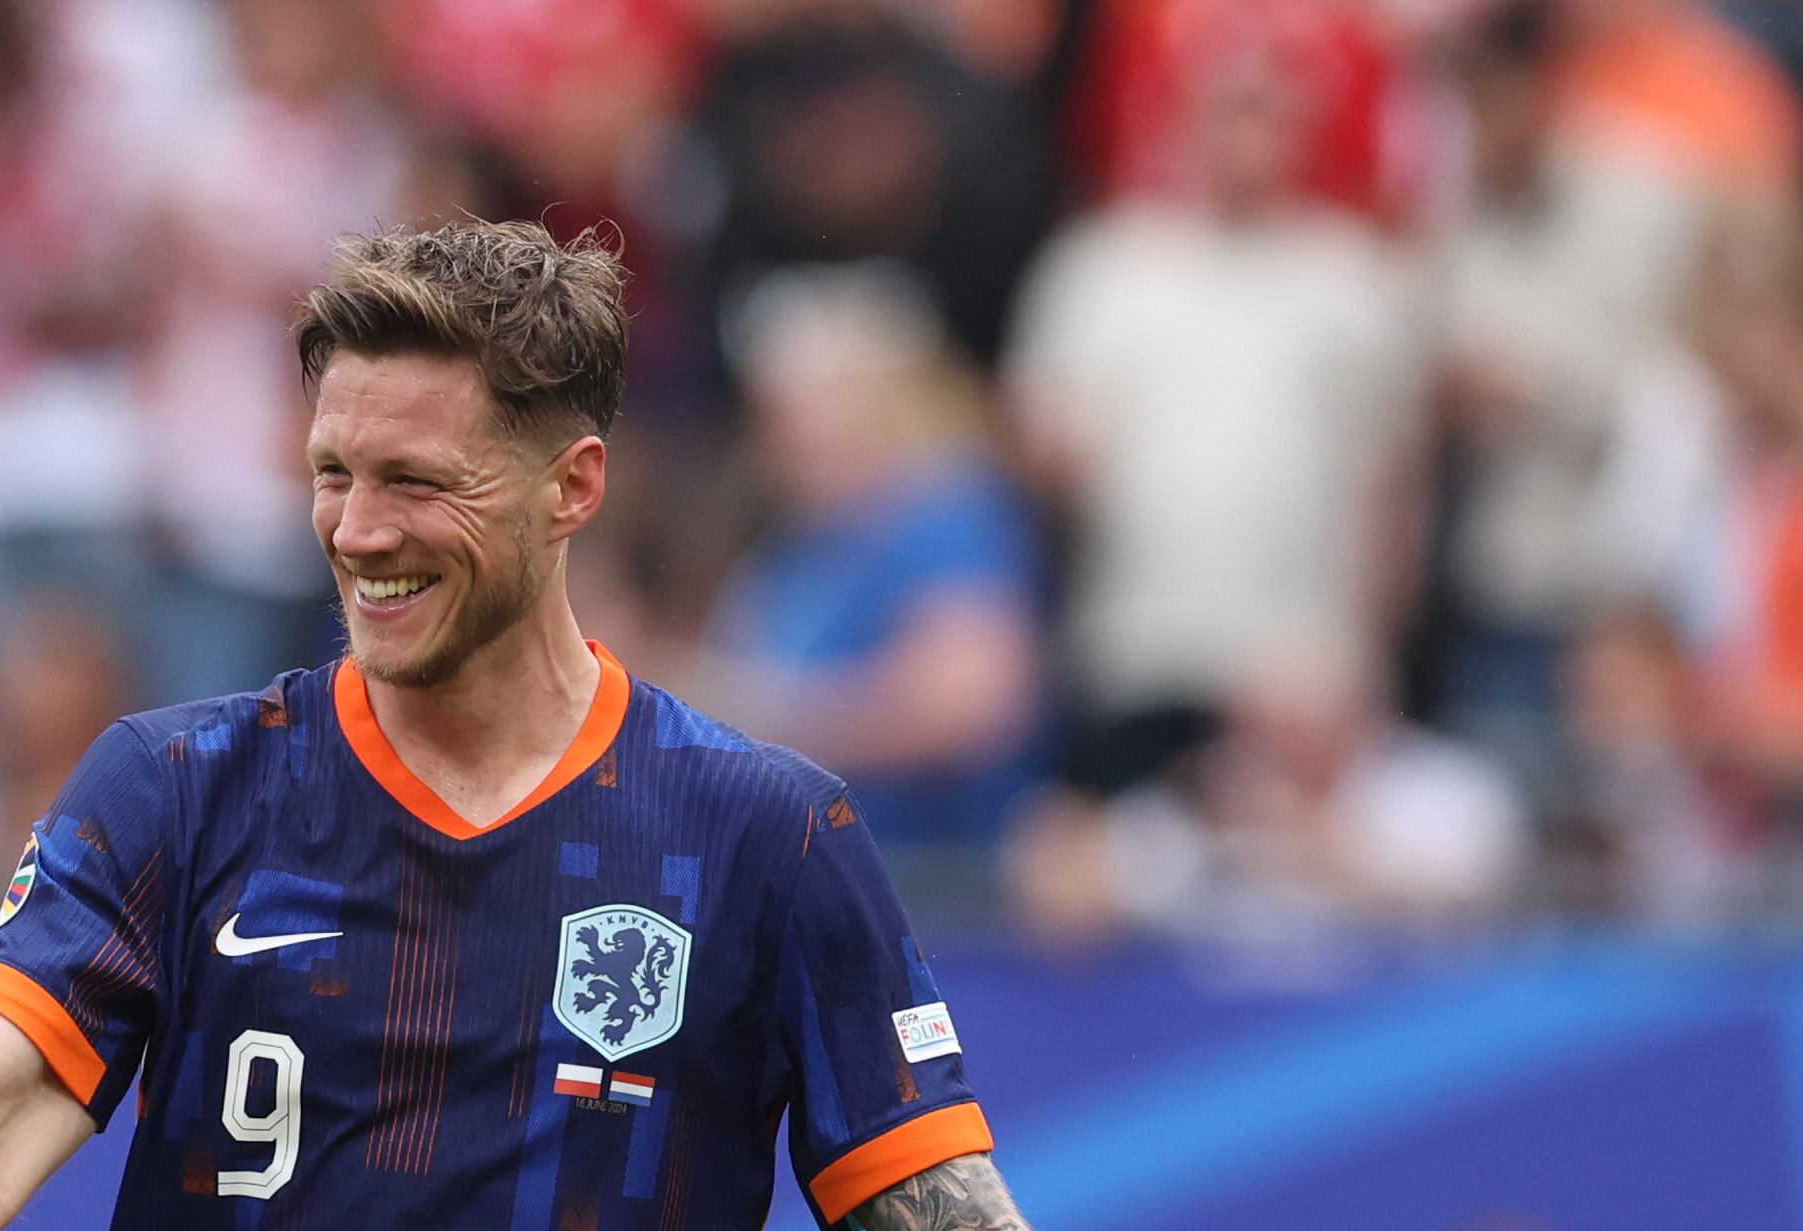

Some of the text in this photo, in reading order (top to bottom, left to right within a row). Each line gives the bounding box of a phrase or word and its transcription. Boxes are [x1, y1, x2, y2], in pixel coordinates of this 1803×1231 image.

[606, 914, 649, 929] KNVB
[900, 1020, 950, 1045] FOUN
[217, 1029, 305, 1200] 9
